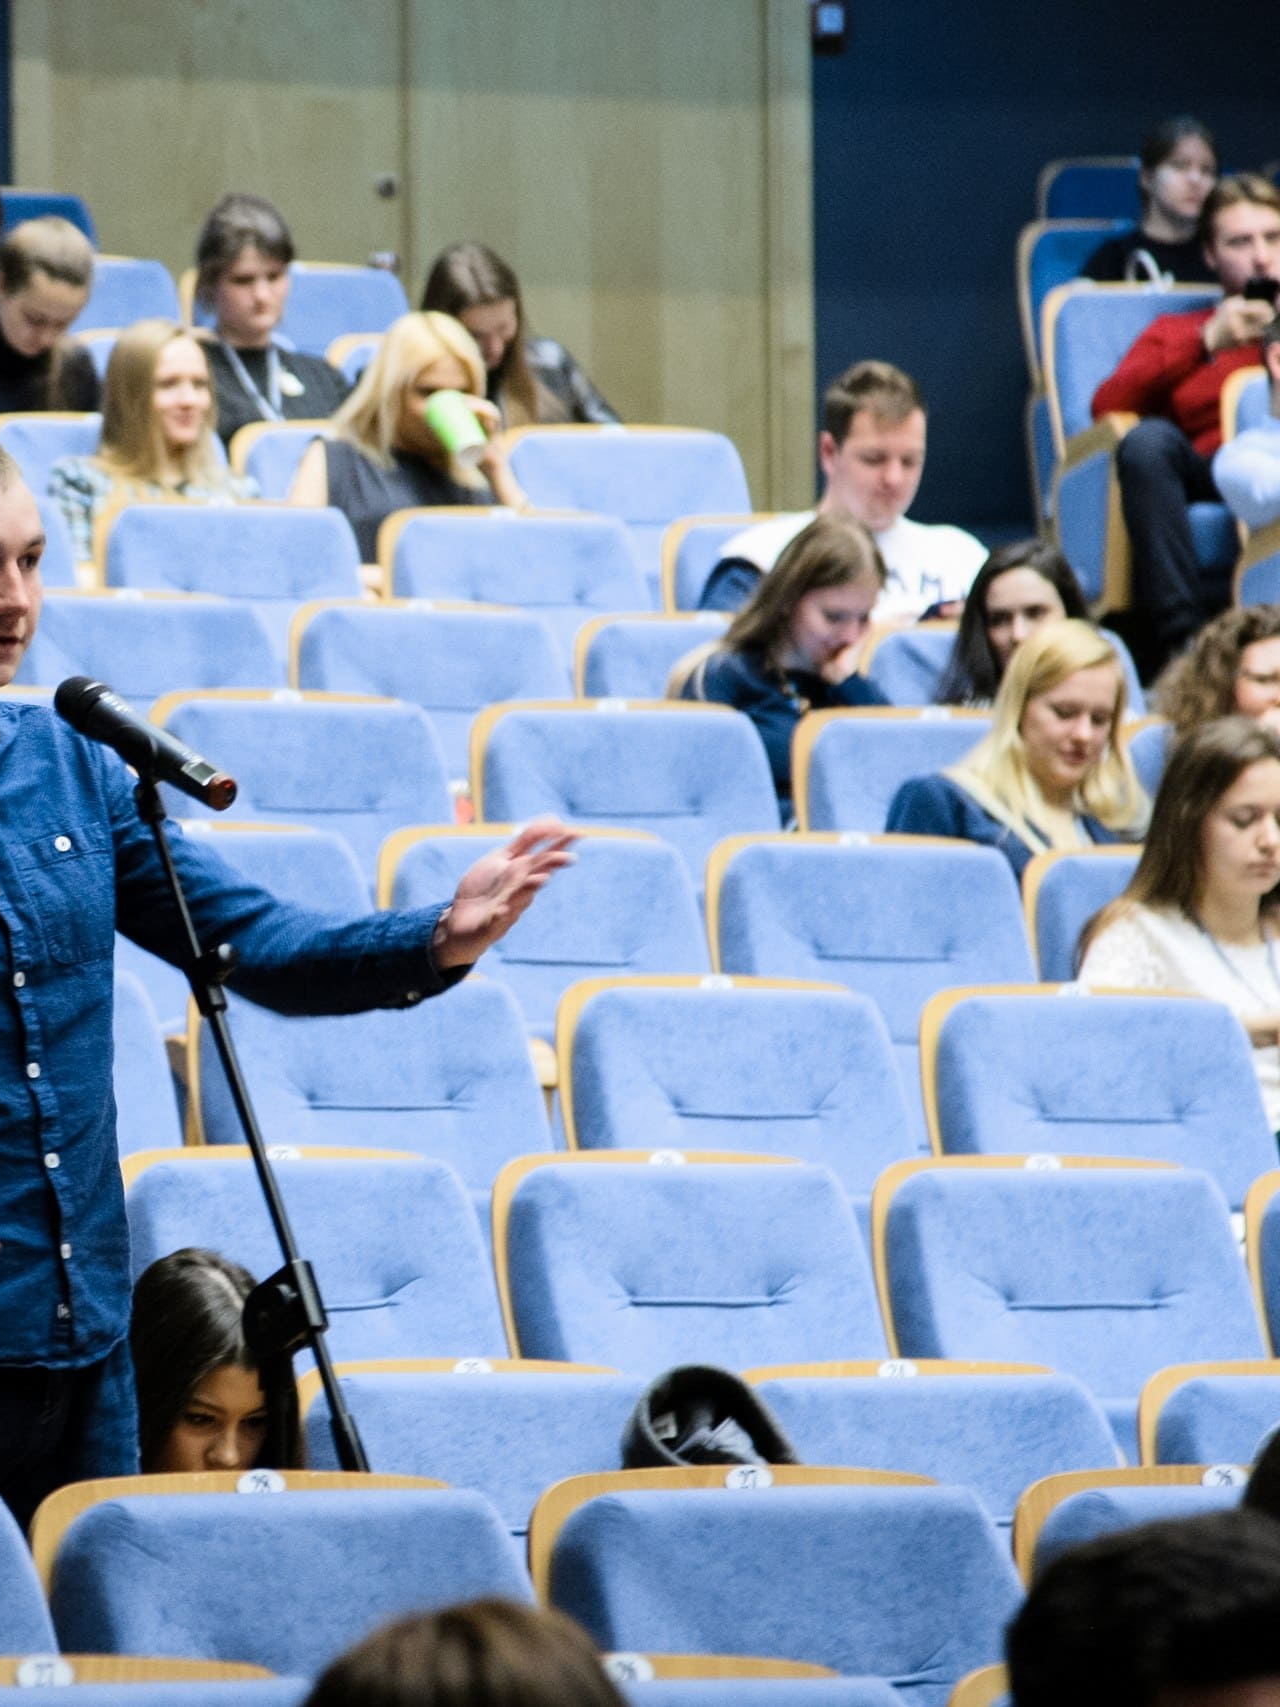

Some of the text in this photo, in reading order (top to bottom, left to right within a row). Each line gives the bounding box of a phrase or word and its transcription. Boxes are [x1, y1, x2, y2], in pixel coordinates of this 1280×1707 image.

[738, 1469, 758, 1489] 27
[1214, 1470, 1233, 1487] 26
[33, 1662, 55, 1688] 27
